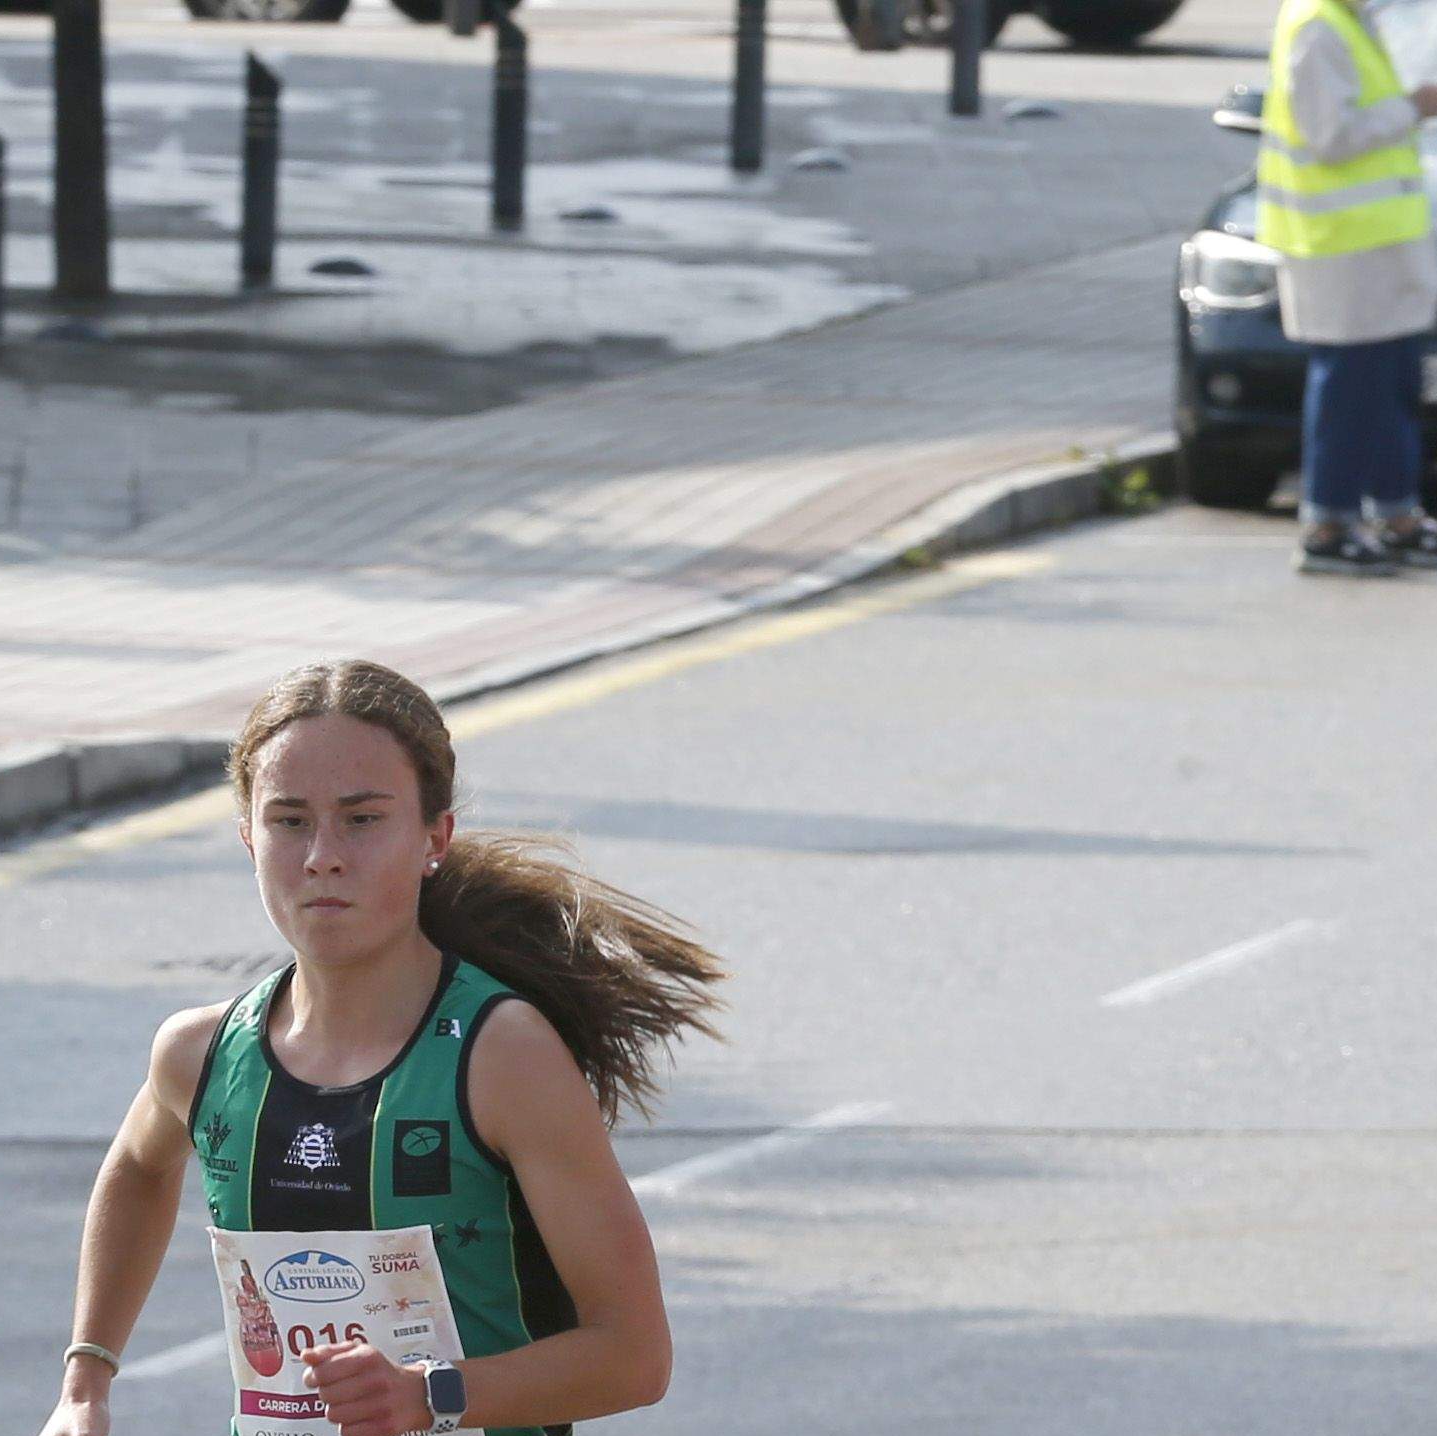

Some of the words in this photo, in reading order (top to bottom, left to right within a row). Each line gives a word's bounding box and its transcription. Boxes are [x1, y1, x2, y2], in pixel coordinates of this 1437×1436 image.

[314, 1180, 323, 1190] de
[381, 1251, 418, 1261] DORSAL
[372, 1260, 420, 1274] SUMA
[273, 1270, 360, 1291] ASTURIANA
[287, 1323, 368, 1356] 016
[258, 1398, 311, 1413] CARRERA
